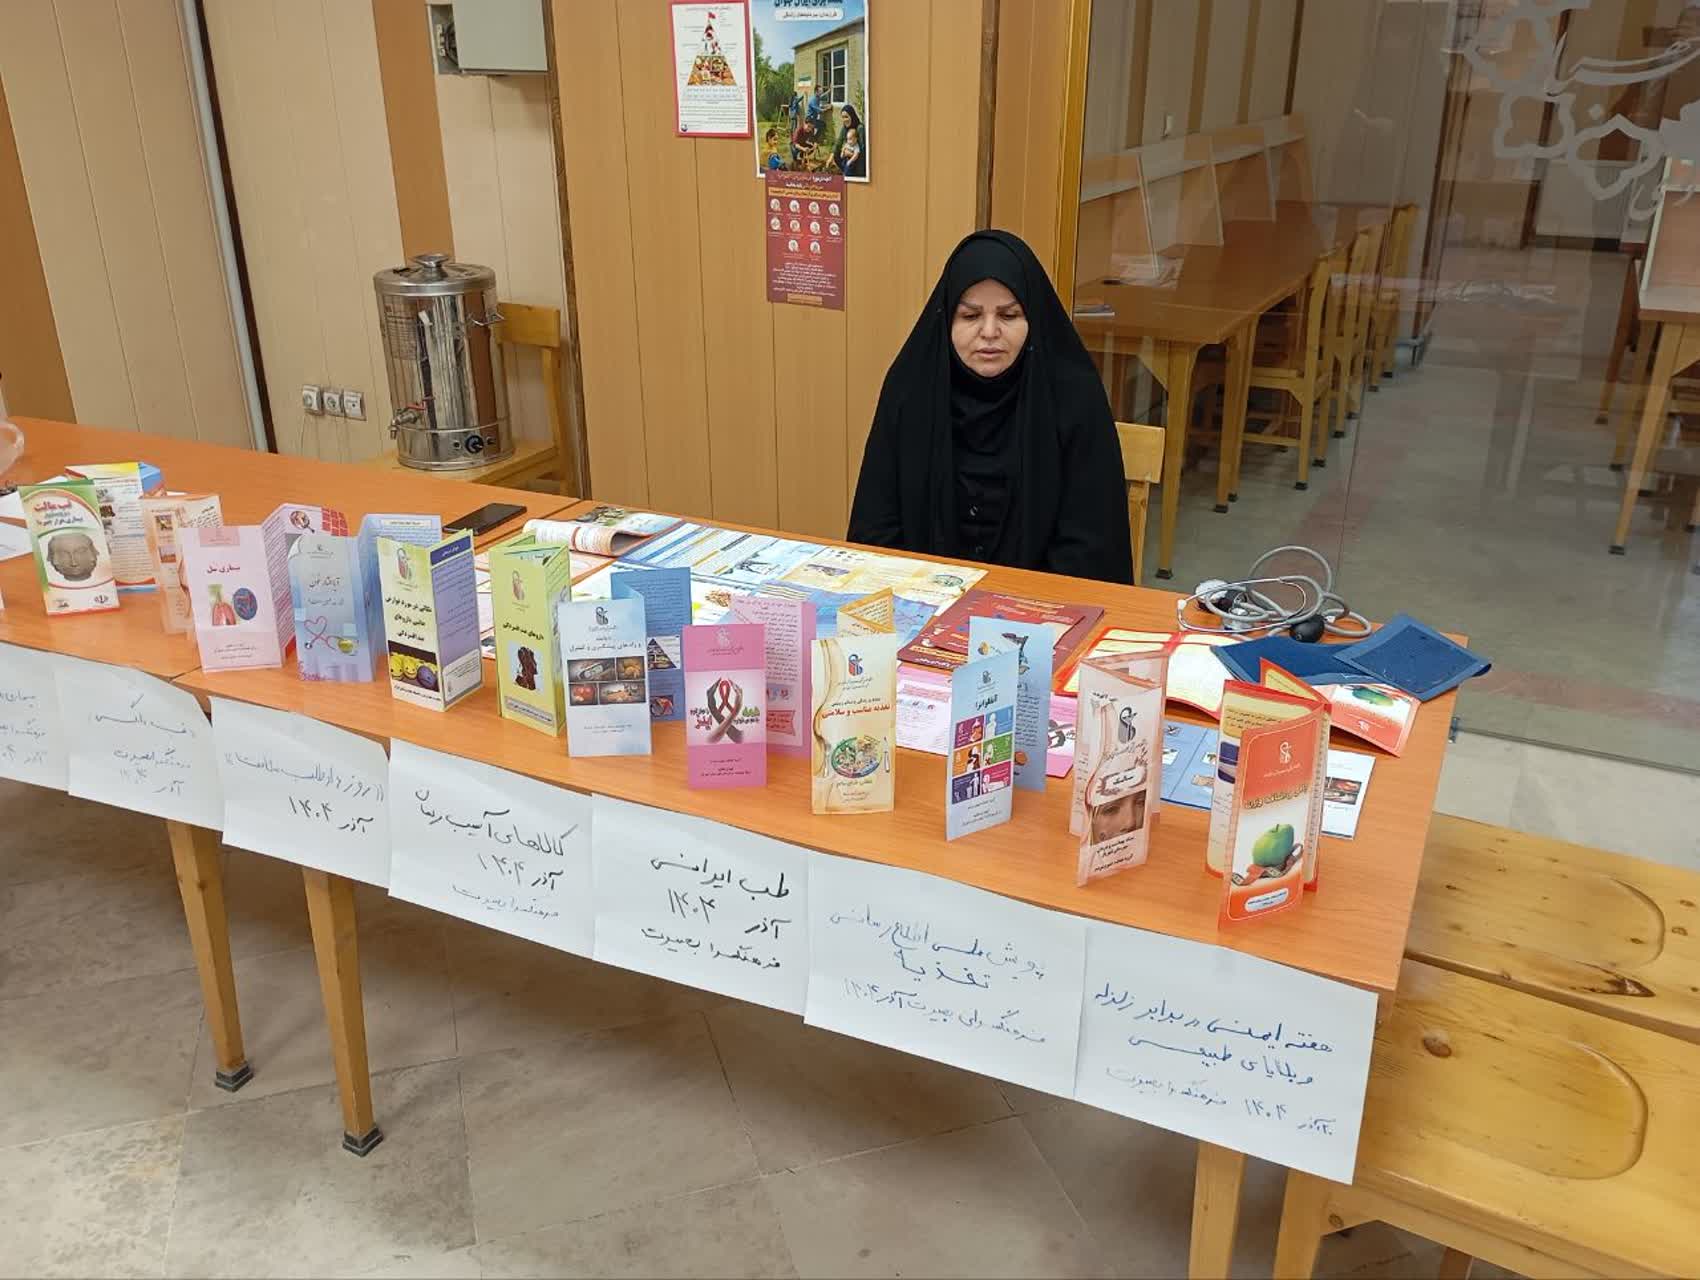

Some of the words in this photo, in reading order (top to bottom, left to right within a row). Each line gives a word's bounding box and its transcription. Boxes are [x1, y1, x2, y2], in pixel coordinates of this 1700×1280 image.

[218, 564, 241, 574] بیماری
[821, 708, 846, 719] سلامتی
[852, 705, 872, 714] مناسب
[288, 795, 333, 821] ۱۴۰۴
[338, 816, 374, 834] آذر
[445, 808, 511, 838] آسیب
[494, 823, 579, 857] کالاهای
[477, 852, 525, 886] ۱۴۰۴
[531, 869, 564, 891] آذر
[650, 852, 732, 889] ایرانی
[739, 871, 790, 902] طب
[668, 887, 716, 924] ۱۴۰۴
[641, 927, 701, 956] بصیرت
[744, 917, 792, 940] آذر
[709, 942, 781, 969] فرهنگسرا
[932, 938, 984, 956] ملی
[985, 943, 1046, 981] پویش
[875, 989, 918, 1009] آذر
[1094, 982, 1136, 1012] زلزله
[1133, 999, 1184, 1024] برابر
[1206, 1019, 1283, 1050] ایمنی
[1283, 1031, 1334, 1053] هفته
[1128, 1033, 1233, 1069] طبیعی
[1296, 1074, 1314, 1086] و
[1243, 1098, 1288, 1121] ۱۴۰۴
